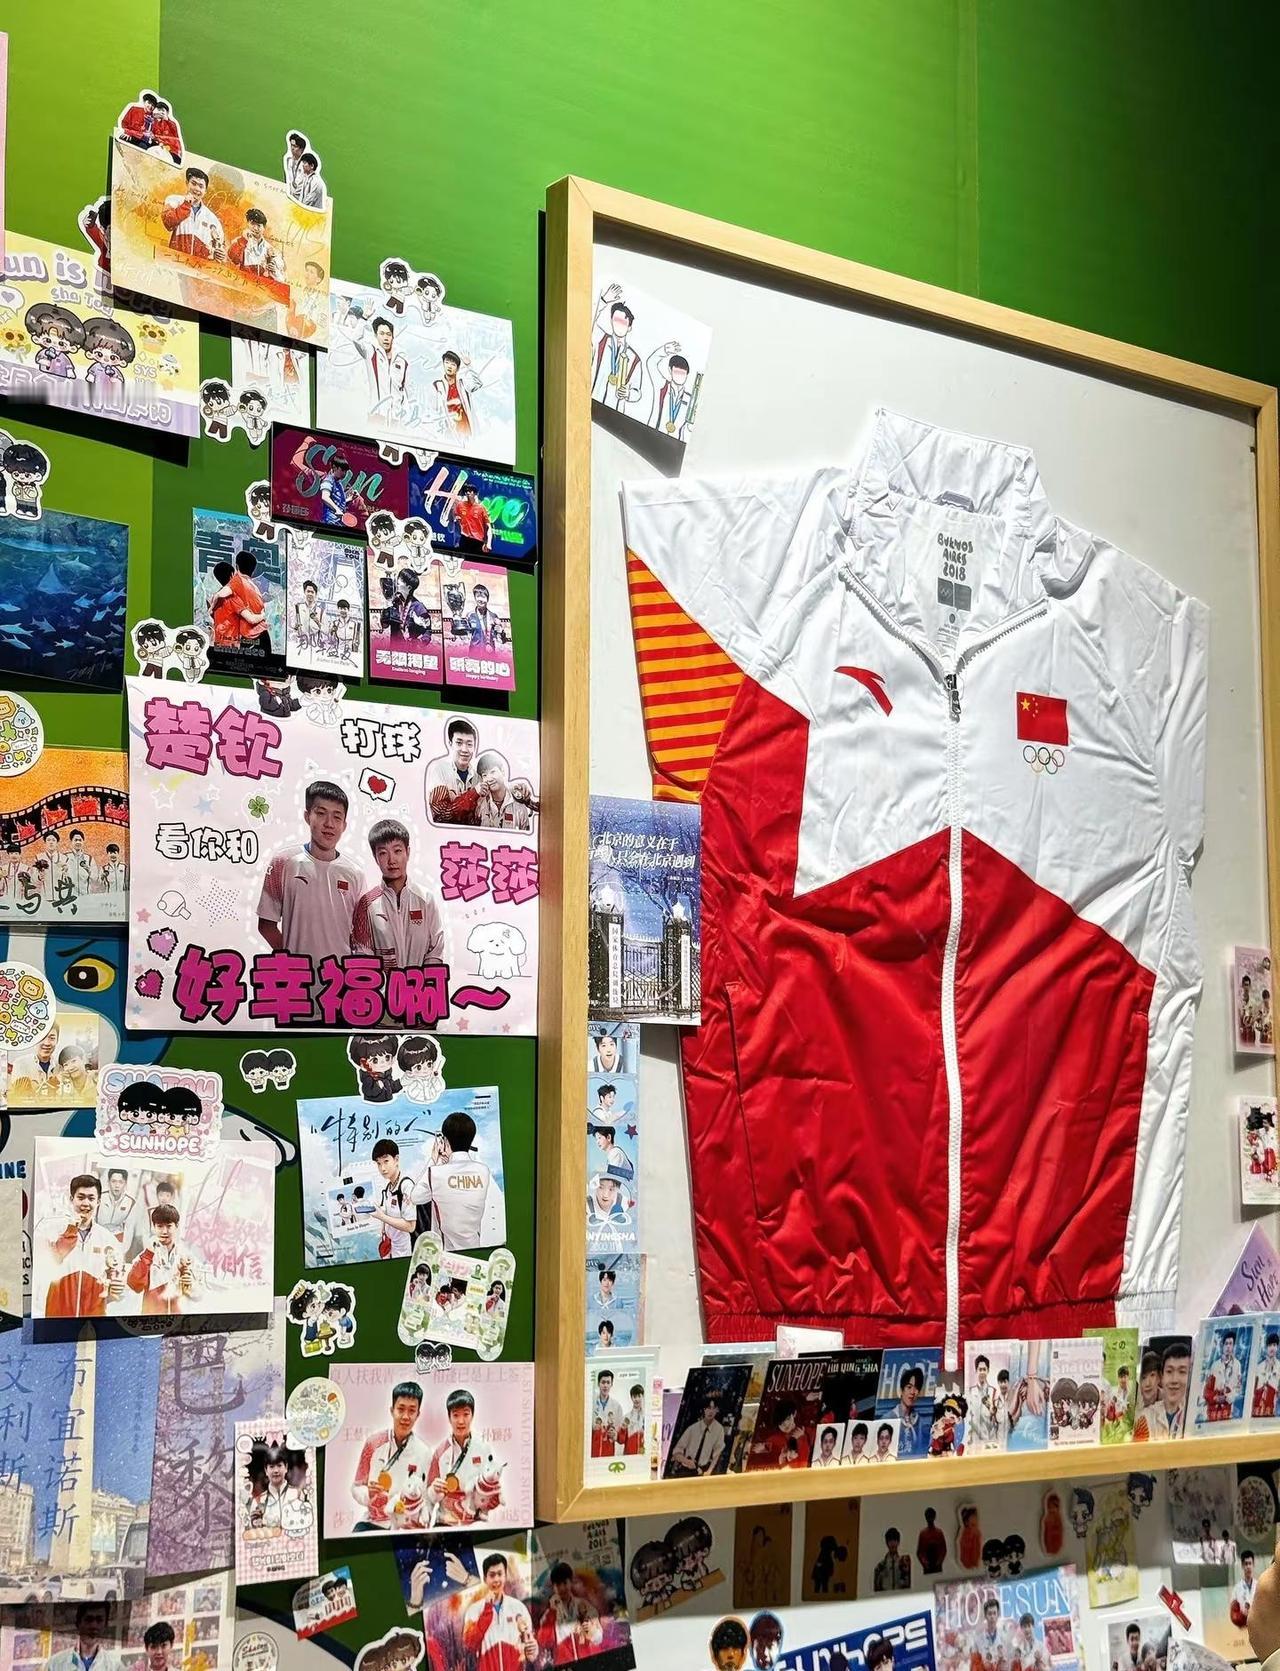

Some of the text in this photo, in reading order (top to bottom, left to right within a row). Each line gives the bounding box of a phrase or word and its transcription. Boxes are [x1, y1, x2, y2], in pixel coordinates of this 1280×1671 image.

[0, 253, 48, 282] un
[134, 364, 157, 378] SYS
[937, 533, 973, 553] BUENOS
[943, 548, 967, 566] AIRES
[943, 562, 966, 581] 2018
[144, 697, 283, 780] 楚钦
[341, 718, 422, 762] 打球
[155, 822, 259, 864] 看你和
[440, 841, 540, 905] 莎莎
[0, 878, 78, 915] 与共
[119, 1134, 201, 1153] SUNHOPE
[448, 1175, 484, 1190] CHINA
[767, 1362, 827, 1393] SUNHOPE
[38, 1357, 93, 1545] 布宜诺斯
[169, 1335, 246, 1538] 巴黎
